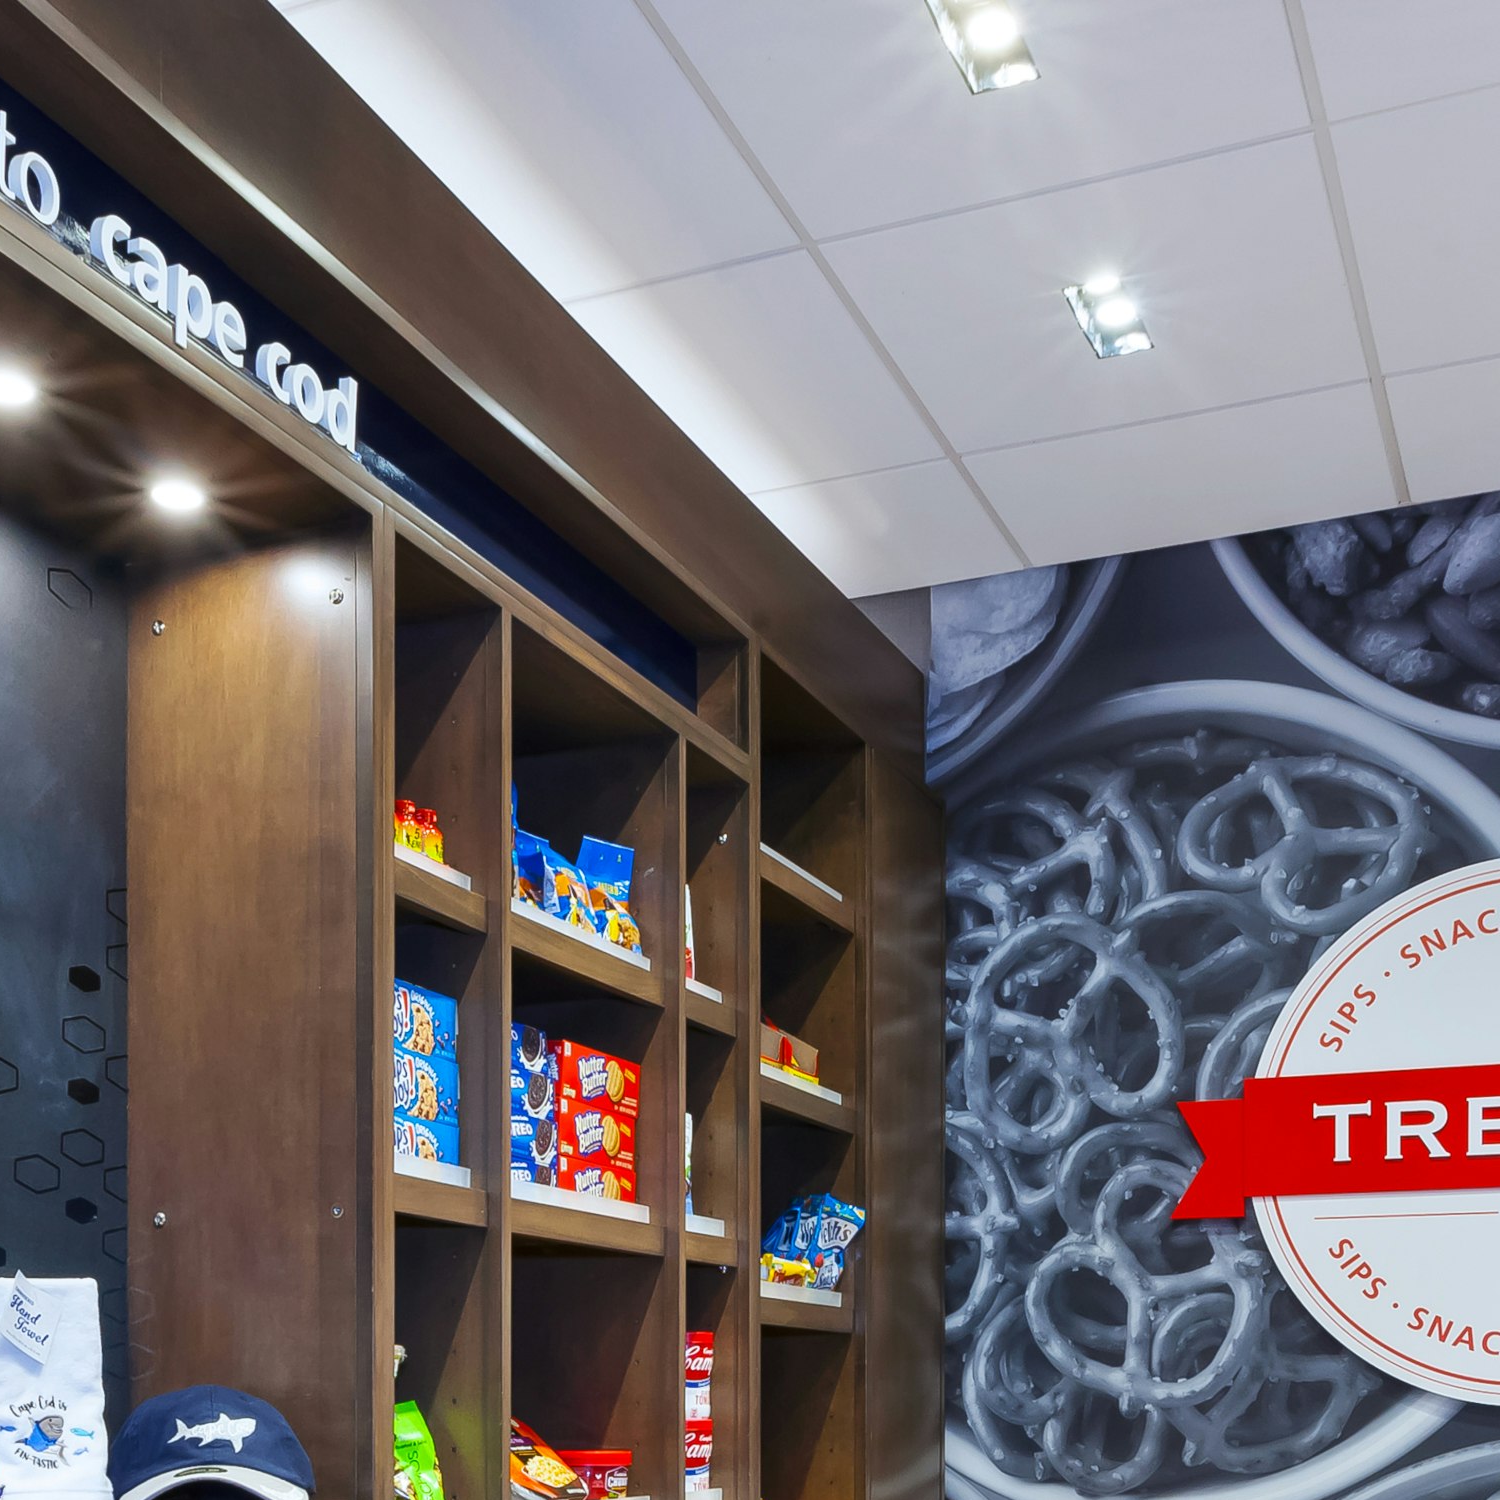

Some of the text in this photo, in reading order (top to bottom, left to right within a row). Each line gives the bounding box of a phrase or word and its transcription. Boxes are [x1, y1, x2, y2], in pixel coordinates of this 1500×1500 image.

[90, 214, 247, 368] cape
[255, 341, 358, 453] cod
[1319, 983, 1377, 1053] SIPS
[578, 1055, 606, 1080] Nutter
[581, 1072, 608, 1099] Butter
[575, 1112, 602, 1135] Nutter
[578, 1126, 604, 1155] Butter
[575, 1168, 602, 1190] Nutter
[1328, 1238, 1389, 1301] SIPS
[10, 1294, 42, 1326] Hand
[14, 1316, 50, 1346] Towel
[9, 1400, 36, 1418] Cape
[58, 1399, 68, 1412] is
[14, 1447, 60, 1470] FIN-TASTIC
